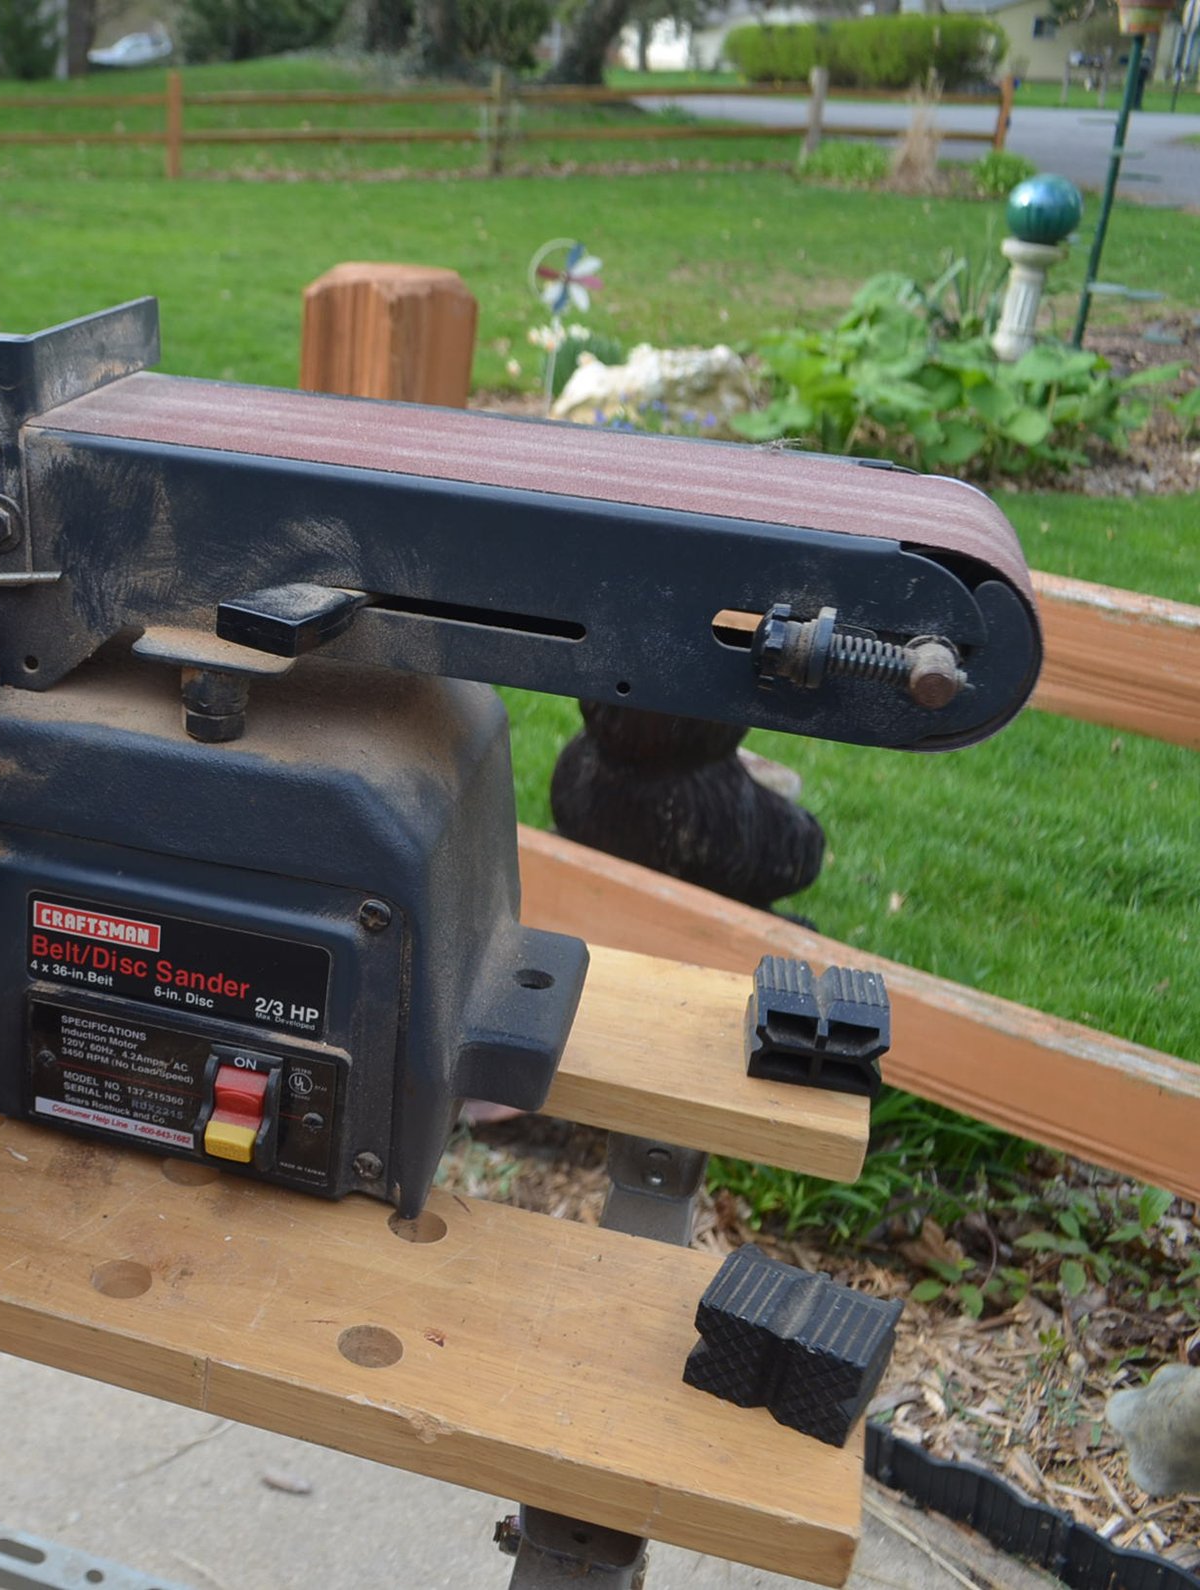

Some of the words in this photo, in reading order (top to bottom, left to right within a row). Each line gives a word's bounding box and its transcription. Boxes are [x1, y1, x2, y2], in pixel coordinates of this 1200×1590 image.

[40, 908, 150, 945] CRAFTSMAN
[30, 960, 38, 970] 4
[41, 963, 49, 972] x
[32, 934, 148, 977] Belt/Disc
[155, 959, 250, 999] Sander
[153, 986, 182, 1001] 6-in.
[185, 992, 215, 1008] Disc
[254, 997, 284, 1016] 2/3
[290, 1004, 320, 1023] HP
[60, 1014, 147, 1041] SPECIFICATIONS
[275, 1016, 316, 1031] Developed
[61, 1026, 107, 1043] Induction
[109, 1036, 139, 1050] Motor
[61, 1047, 84, 1059] 3450
[86, 1053, 110, 1065] RPM
[173, 1062, 189, 1072] AC
[233, 1056, 258, 1071] ON
[63, 1071, 99, 1086] MODEL
[63, 1081, 102, 1098] SERIAL
[51, 1103, 91, 1119] Consumer
[92, 1112, 111, 1127] Help
[111, 1117, 129, 1129] Line
[64, 1094, 90, 1107] Sears
[91, 1099, 131, 1115] Roebuck
[132, 1109, 150, 1121] and
